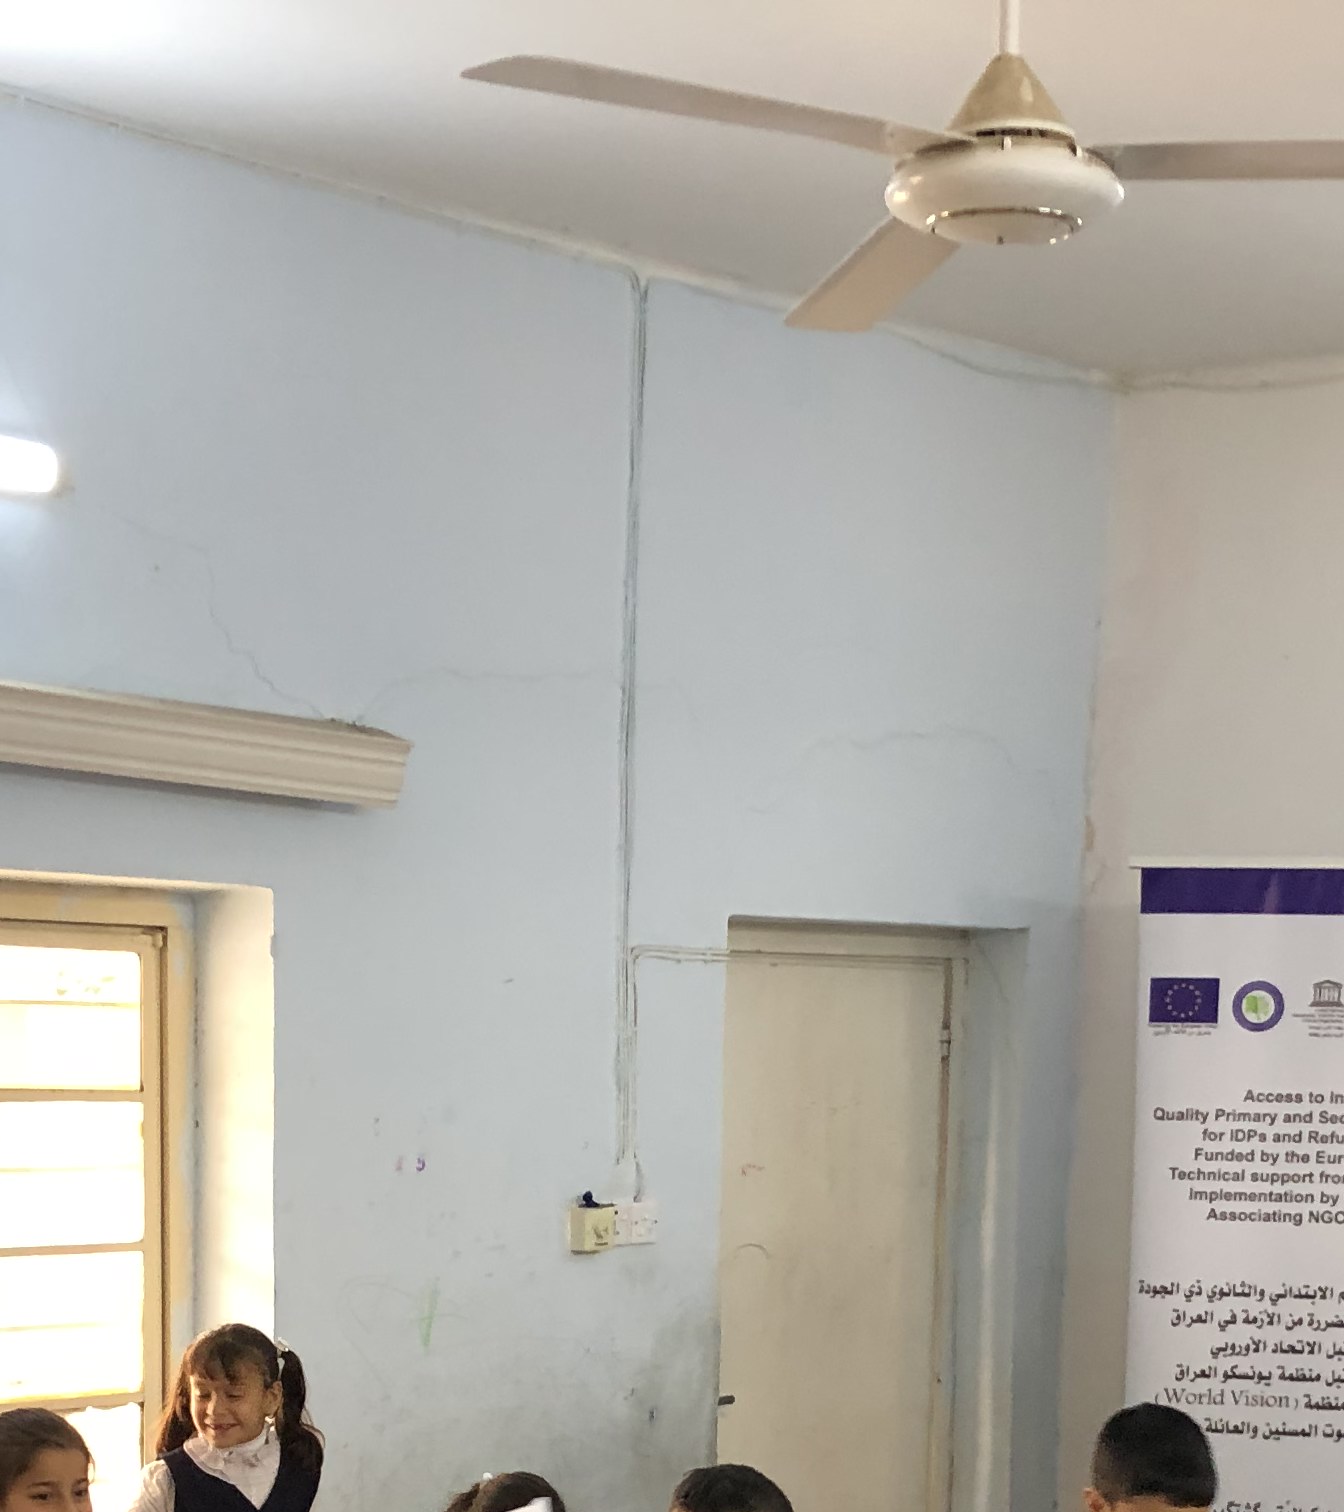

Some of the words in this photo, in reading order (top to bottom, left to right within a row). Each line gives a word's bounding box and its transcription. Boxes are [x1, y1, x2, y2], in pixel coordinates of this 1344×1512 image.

[1243, 1089, 1304, 1104] Access
[1308, 1091, 1325, 1105] to
[1153, 1106, 1209, 1125] Quality
[1214, 1108, 1278, 1127] Primary
[1282, 1110, 1313, 1125] and
[1201, 1127, 1226, 1142] for
[1229, 1128, 1267, 1144] IDPs
[1272, 1130, 1303, 1144] and
[1193, 1147, 1256, 1163] Funded
[1260, 1149, 1280, 1166] by
[1284, 1150, 1311, 1164] the
[1168, 1166, 1246, 1182] Technical
[1250, 1170, 1315, 1187] support
[1188, 1187, 1315, 1205] Implementation
[1319, 1191, 1340, 1207] by
[1206, 1207, 1304, 1227] Associating
[1138, 1279, 1181, 1300] الجودة
[1183, 1279, 1204, 1304] ذي
[1206, 1280, 1267, 1304] والثانوي
[1170, 1308, 1215, 1329] العراق
[1217, 1308, 1239, 1333] في
[1241, 1308, 1282, 1330] الأزمة
[1284, 1312, 1304, 1332] من
[1209, 1335, 1268, 1360] الأوروبي
[1270, 1338, 1323, 1356] الاتحاد
[1174, 1363, 1218, 1383] العراق
[1221, 1364, 1273, 1387] يونسكو
[1276, 1365, 1322, 1383] منظمة
